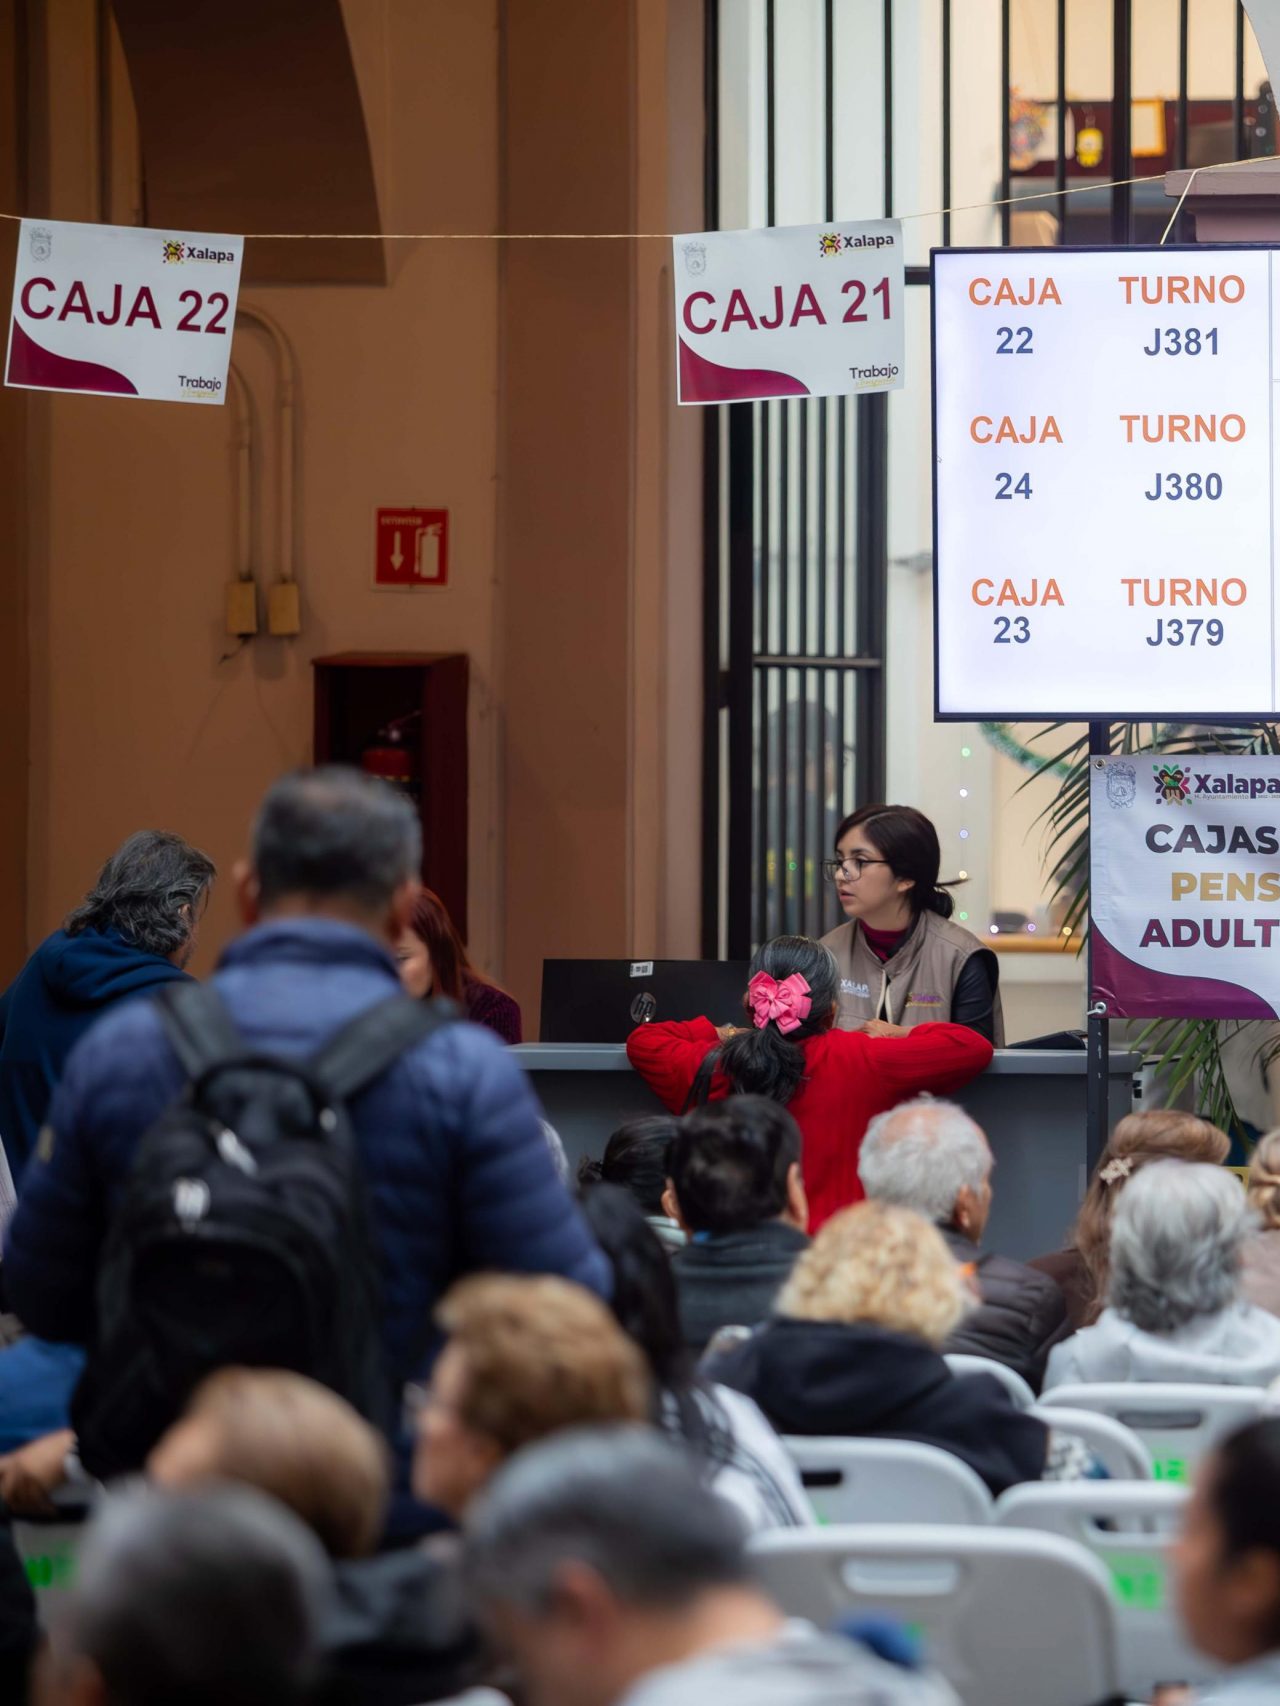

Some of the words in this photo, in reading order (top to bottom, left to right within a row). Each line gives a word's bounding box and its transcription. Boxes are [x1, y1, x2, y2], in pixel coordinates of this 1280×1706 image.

[186, 246, 235, 264] Xalapa
[844, 233, 895, 251] Xalapa
[20, 276, 163, 330] CAJA
[176, 289, 230, 335] 22
[682, 283, 828, 335] CAJA
[840, 276, 891, 324] 21
[969, 278, 1063, 307] CAJA
[1118, 275, 1246, 305] TURNO
[995, 326, 1034, 355] 22
[1143, 327, 1221, 357] J381
[178, 375, 222, 391] Trabajo
[849, 363, 899, 379] Trabajo
[969, 415, 1064, 445] CAJA
[1119, 413, 1247, 444] TURNO
[994, 471, 1034, 500] 24
[1144, 472, 1224, 502] J380
[971, 577, 1065, 607] CAJA
[1120, 577, 1248, 607] TURNO
[992, 615, 1032, 644] 23
[1145, 618, 1225, 648] J379
[1145, 823, 1280, 855] CAJAS
